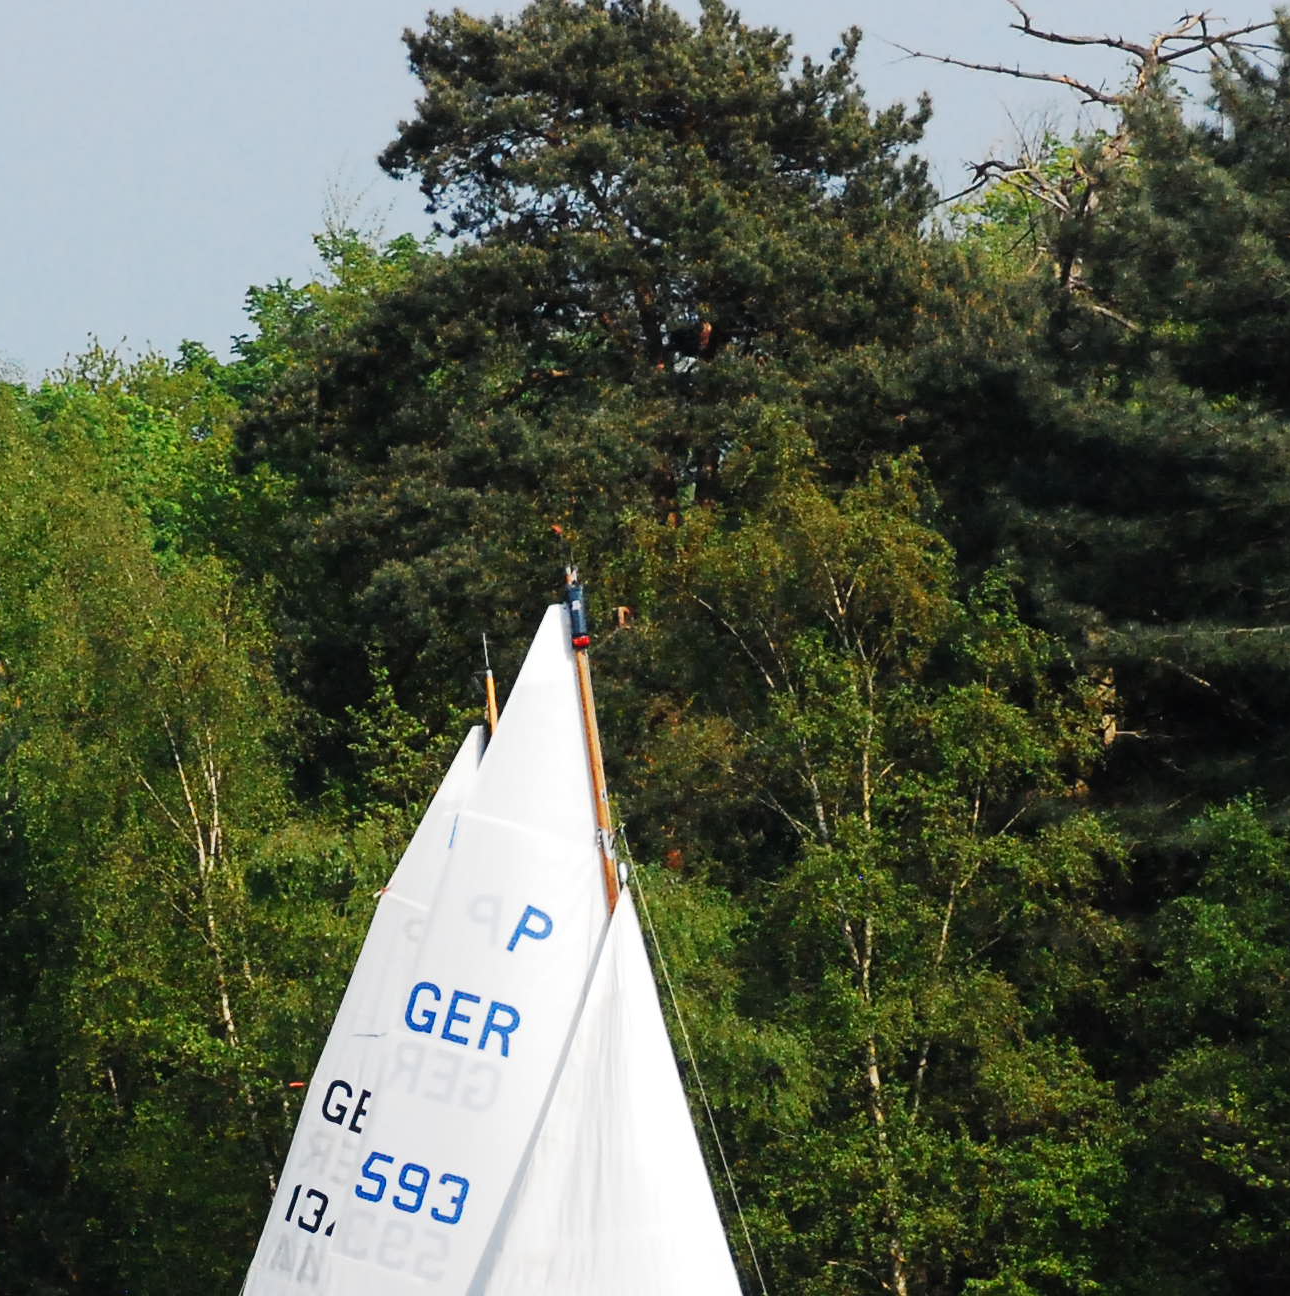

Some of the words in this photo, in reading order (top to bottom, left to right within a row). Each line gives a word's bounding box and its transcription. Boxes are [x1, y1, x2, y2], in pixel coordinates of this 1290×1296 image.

[506, 904, 554, 952] P
[404, 981, 521, 1058] GER
[354, 1151, 470, 1225] 593
